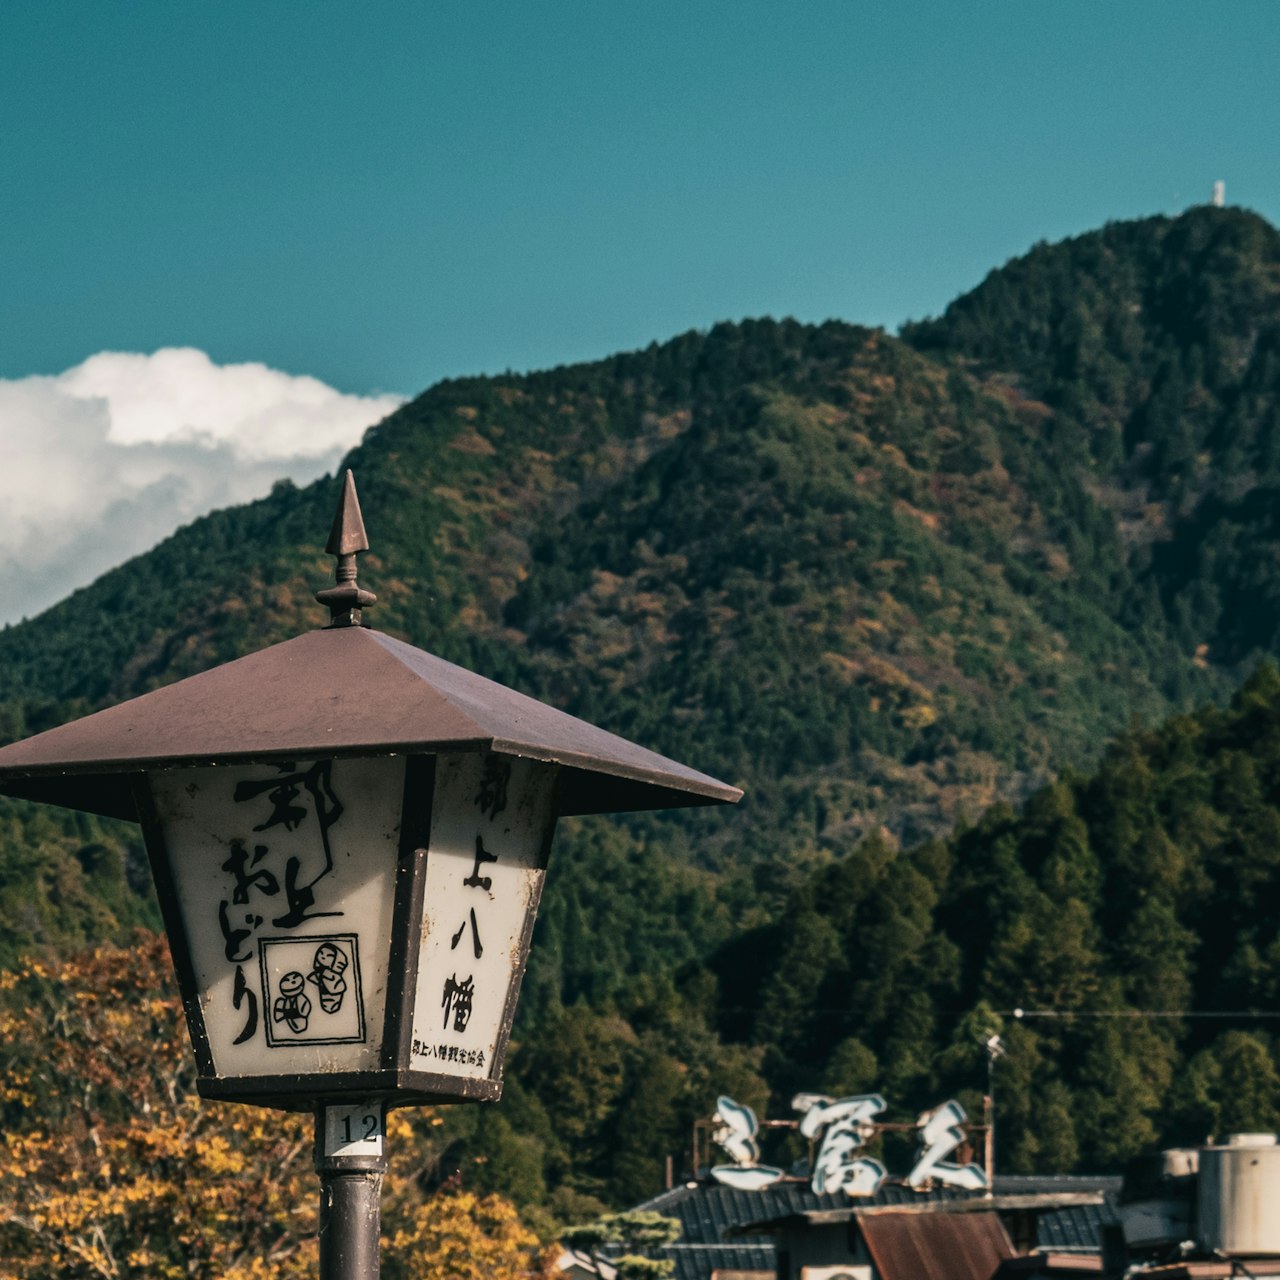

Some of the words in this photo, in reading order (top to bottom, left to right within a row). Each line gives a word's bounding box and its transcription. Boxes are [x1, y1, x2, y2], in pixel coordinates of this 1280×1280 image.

[218, 838, 280, 1046] おどり
[340, 1114, 378, 1143] 12
